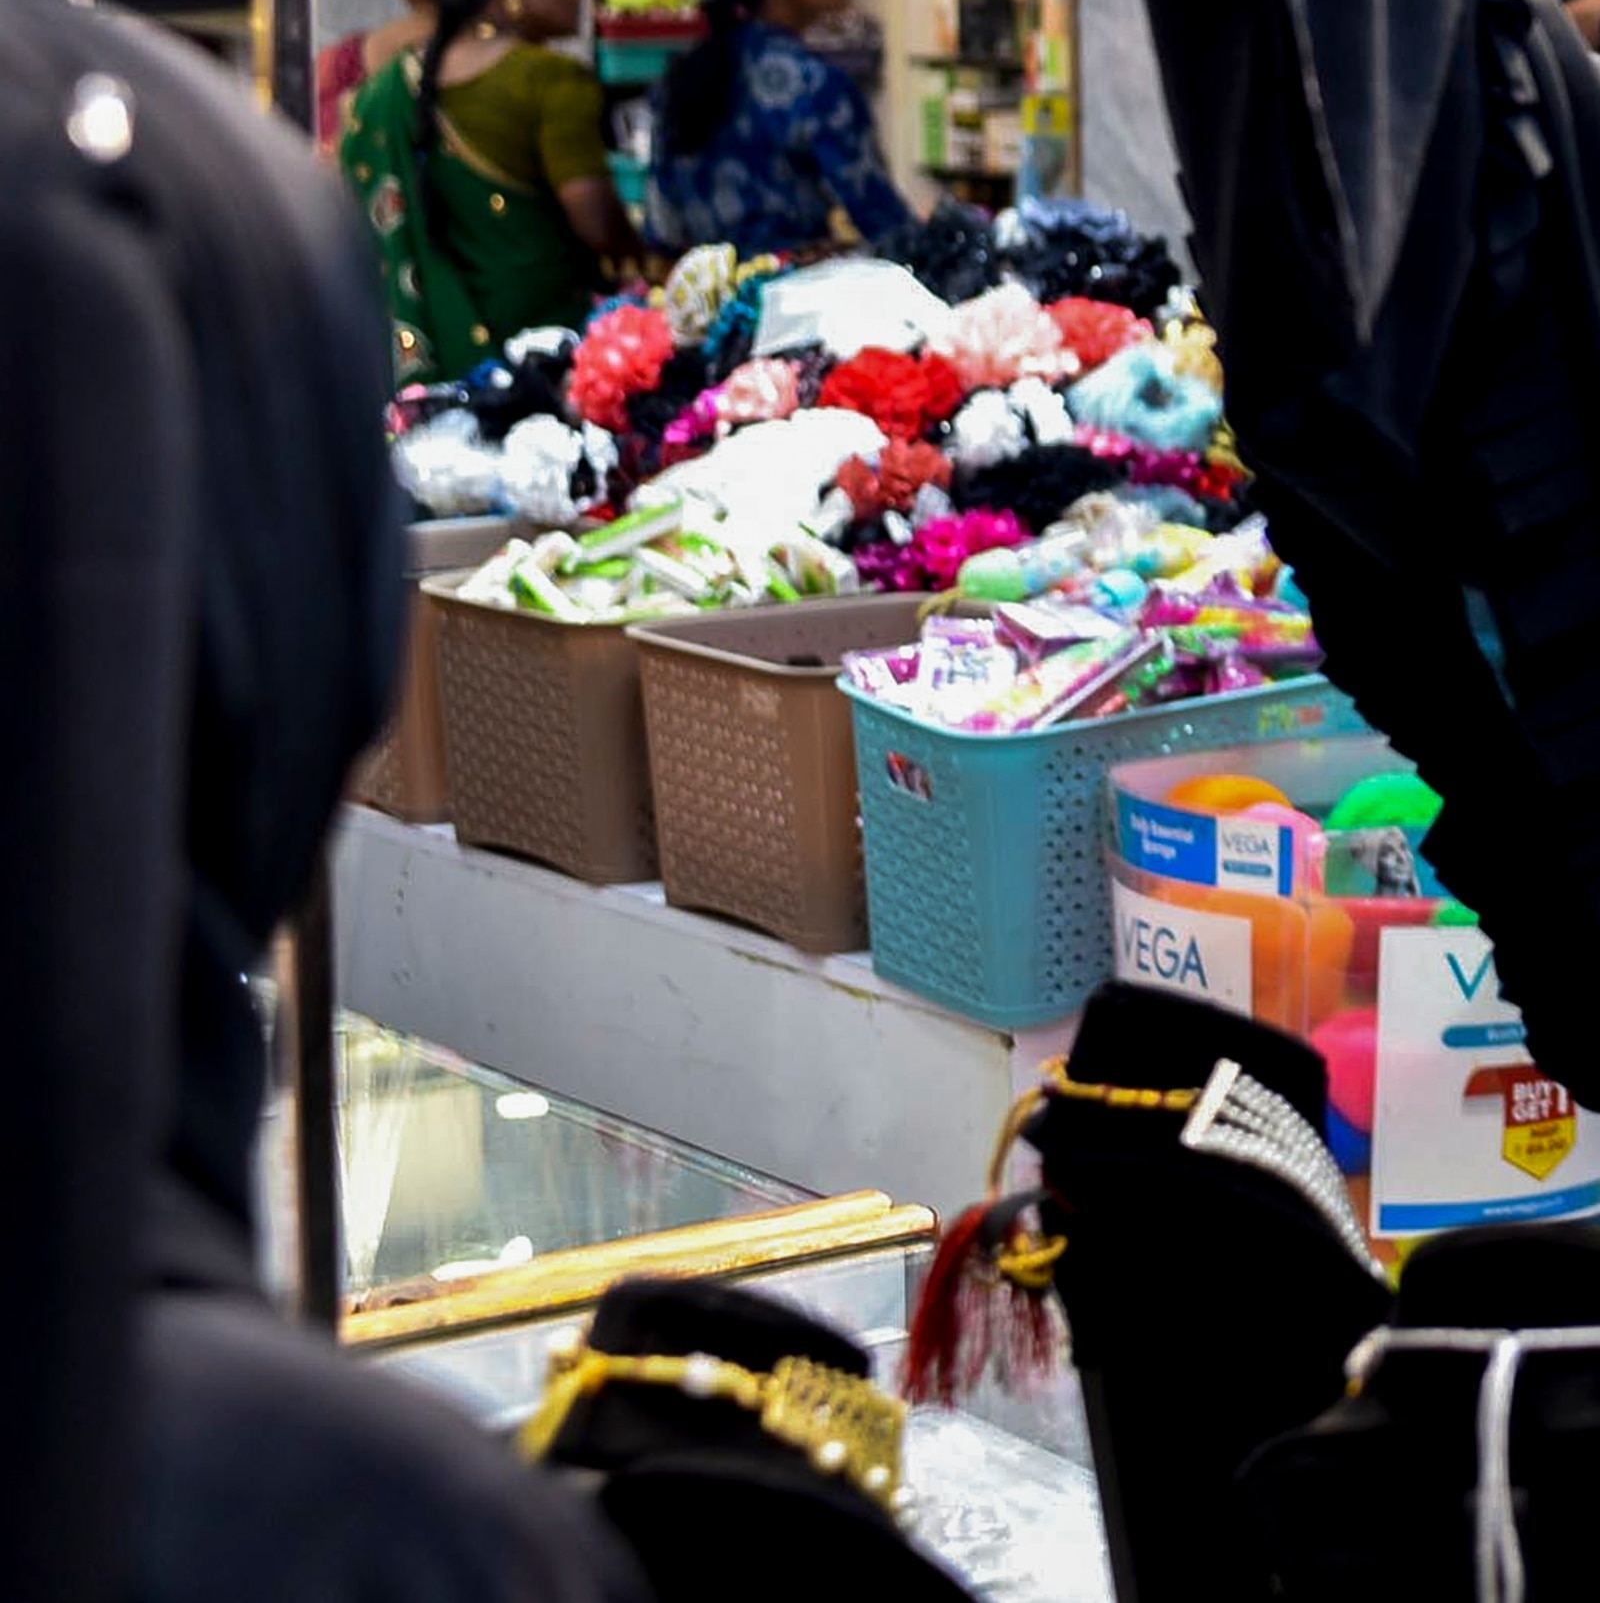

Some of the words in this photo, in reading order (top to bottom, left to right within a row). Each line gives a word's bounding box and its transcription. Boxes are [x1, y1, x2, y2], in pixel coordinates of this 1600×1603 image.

[1221, 830, 1271, 855] VEGA
[1121, 913, 1208, 988] VEGA
[1512, 1079, 1552, 1102] BUY
[1512, 1100, 1552, 1122] GET
